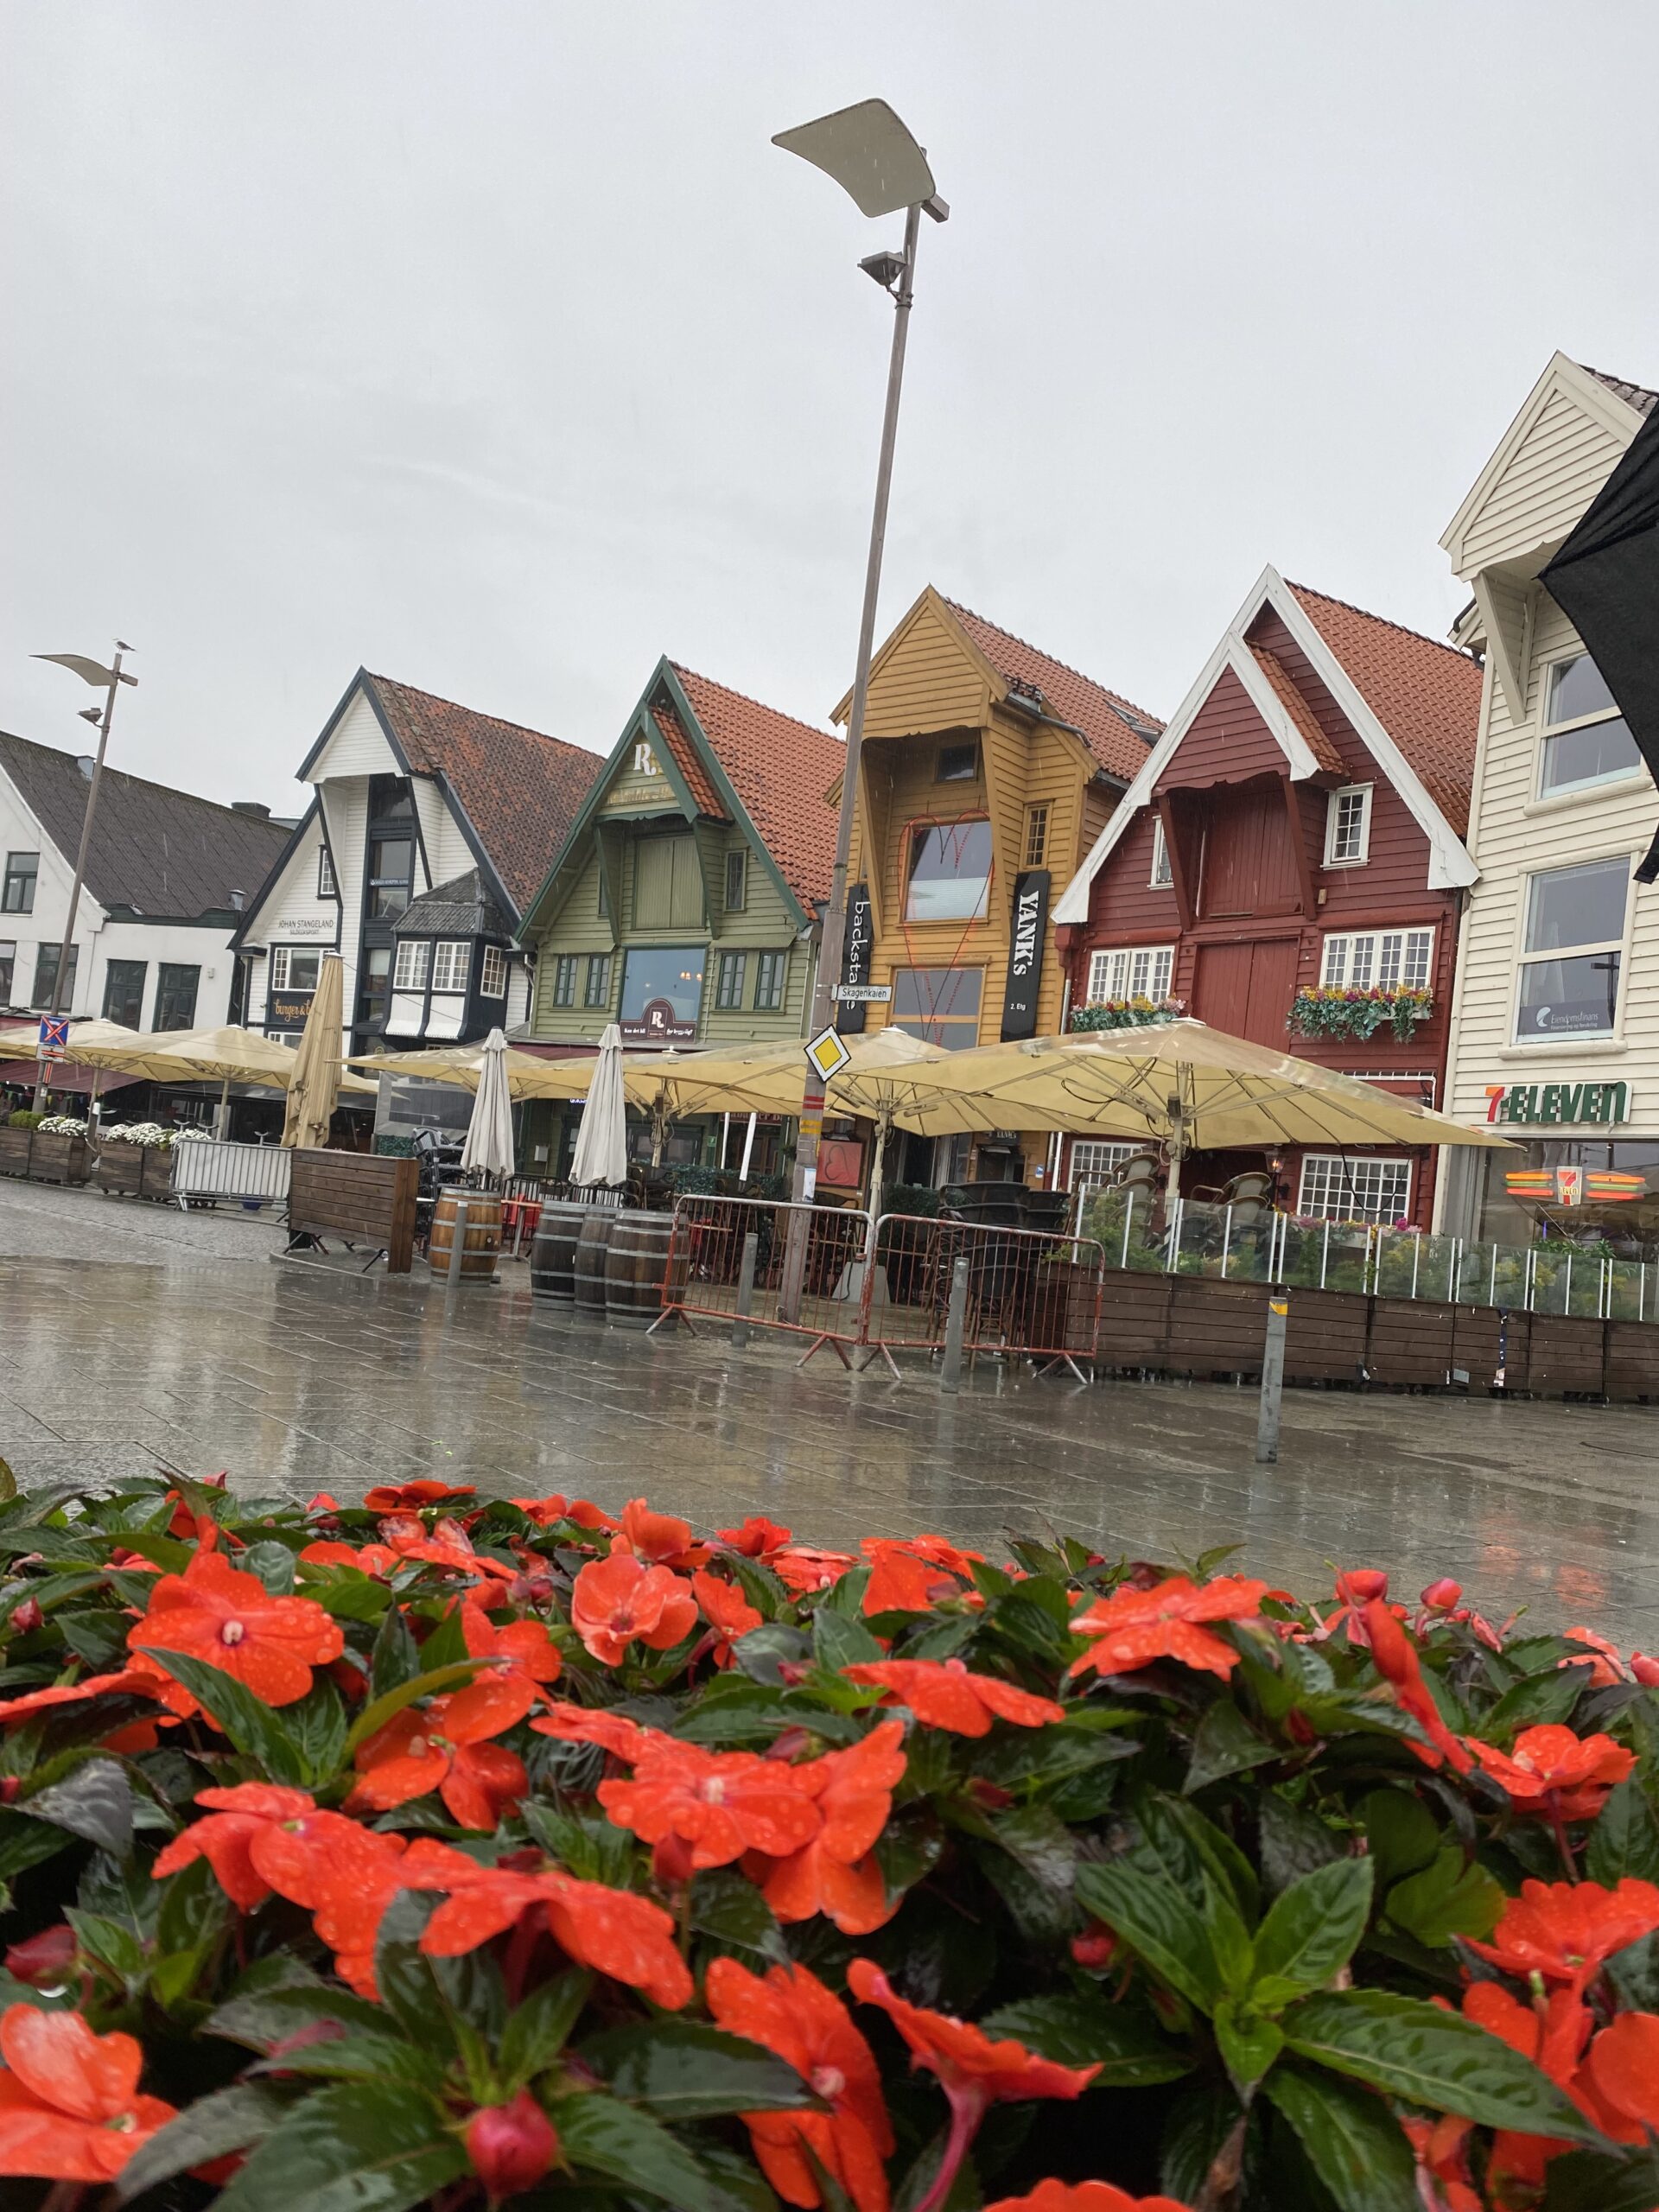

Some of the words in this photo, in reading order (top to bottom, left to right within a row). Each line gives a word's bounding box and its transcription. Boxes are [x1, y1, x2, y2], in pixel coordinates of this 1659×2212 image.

[633, 743, 657, 776] R
[278, 919, 296, 928] JOHAN
[297, 919, 334, 928] STANGELAND
[846, 901, 871, 1010] backstae
[842, 988, 887, 1000] Skagenkaien
[273, 998, 300, 1023] burger
[651, 1011, 665, 1028] R
